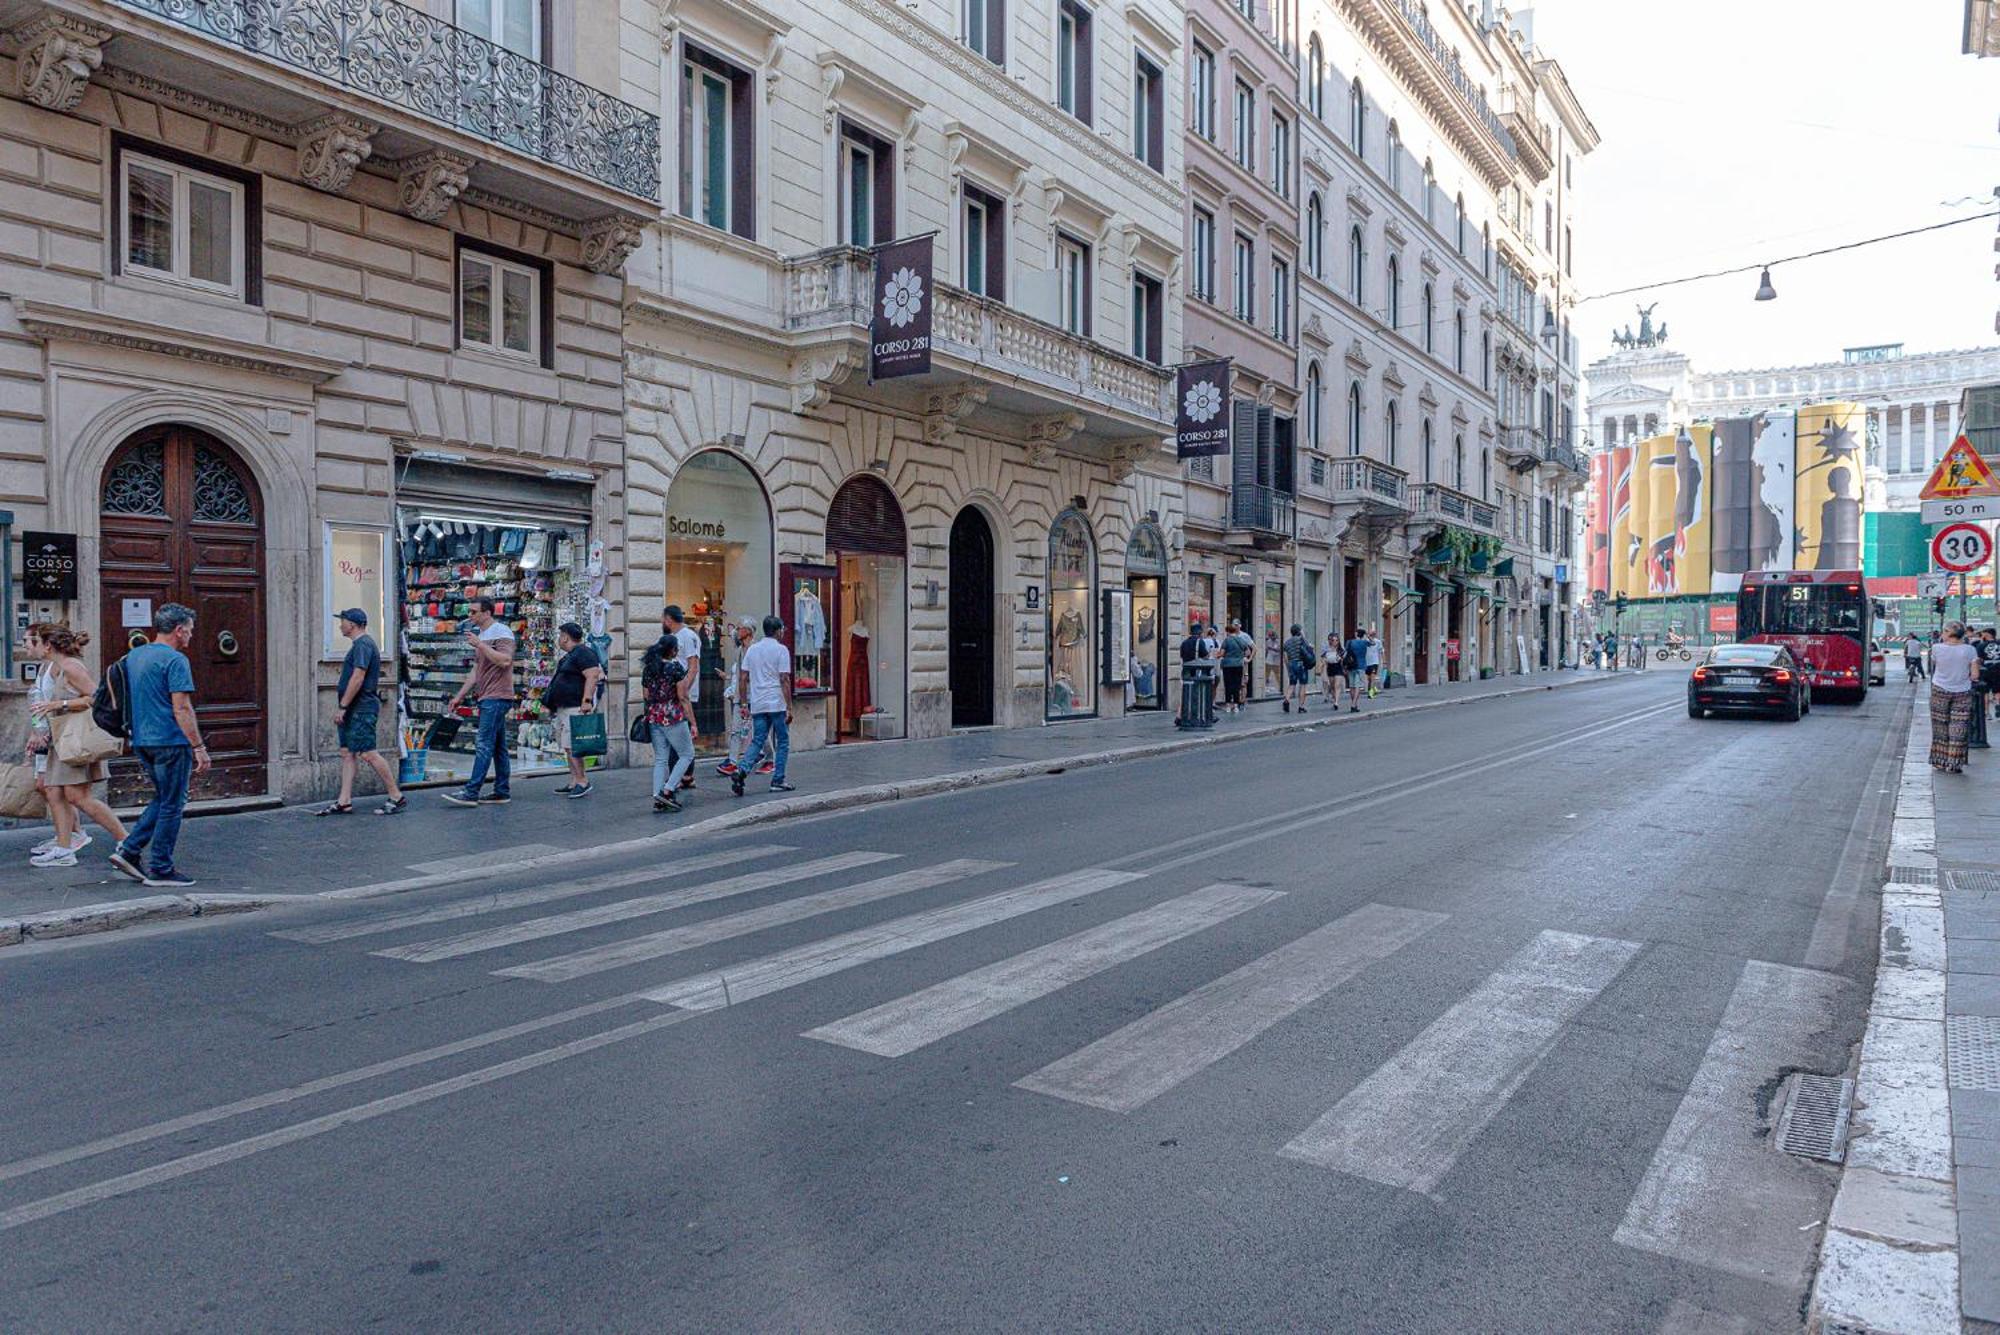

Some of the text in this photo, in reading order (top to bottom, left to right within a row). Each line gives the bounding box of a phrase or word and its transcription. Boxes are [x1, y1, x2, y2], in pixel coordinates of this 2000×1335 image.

[874, 336, 929, 356] CORSO 281
[1179, 429, 1228, 442] CORSO 281
[1944, 504, 1985, 516] 50 m
[669, 515, 725, 537] Salomé
[1946, 536, 1979, 560] 30
[26, 558, 74, 570] CORSO
[1792, 587, 1809, 600] 51
